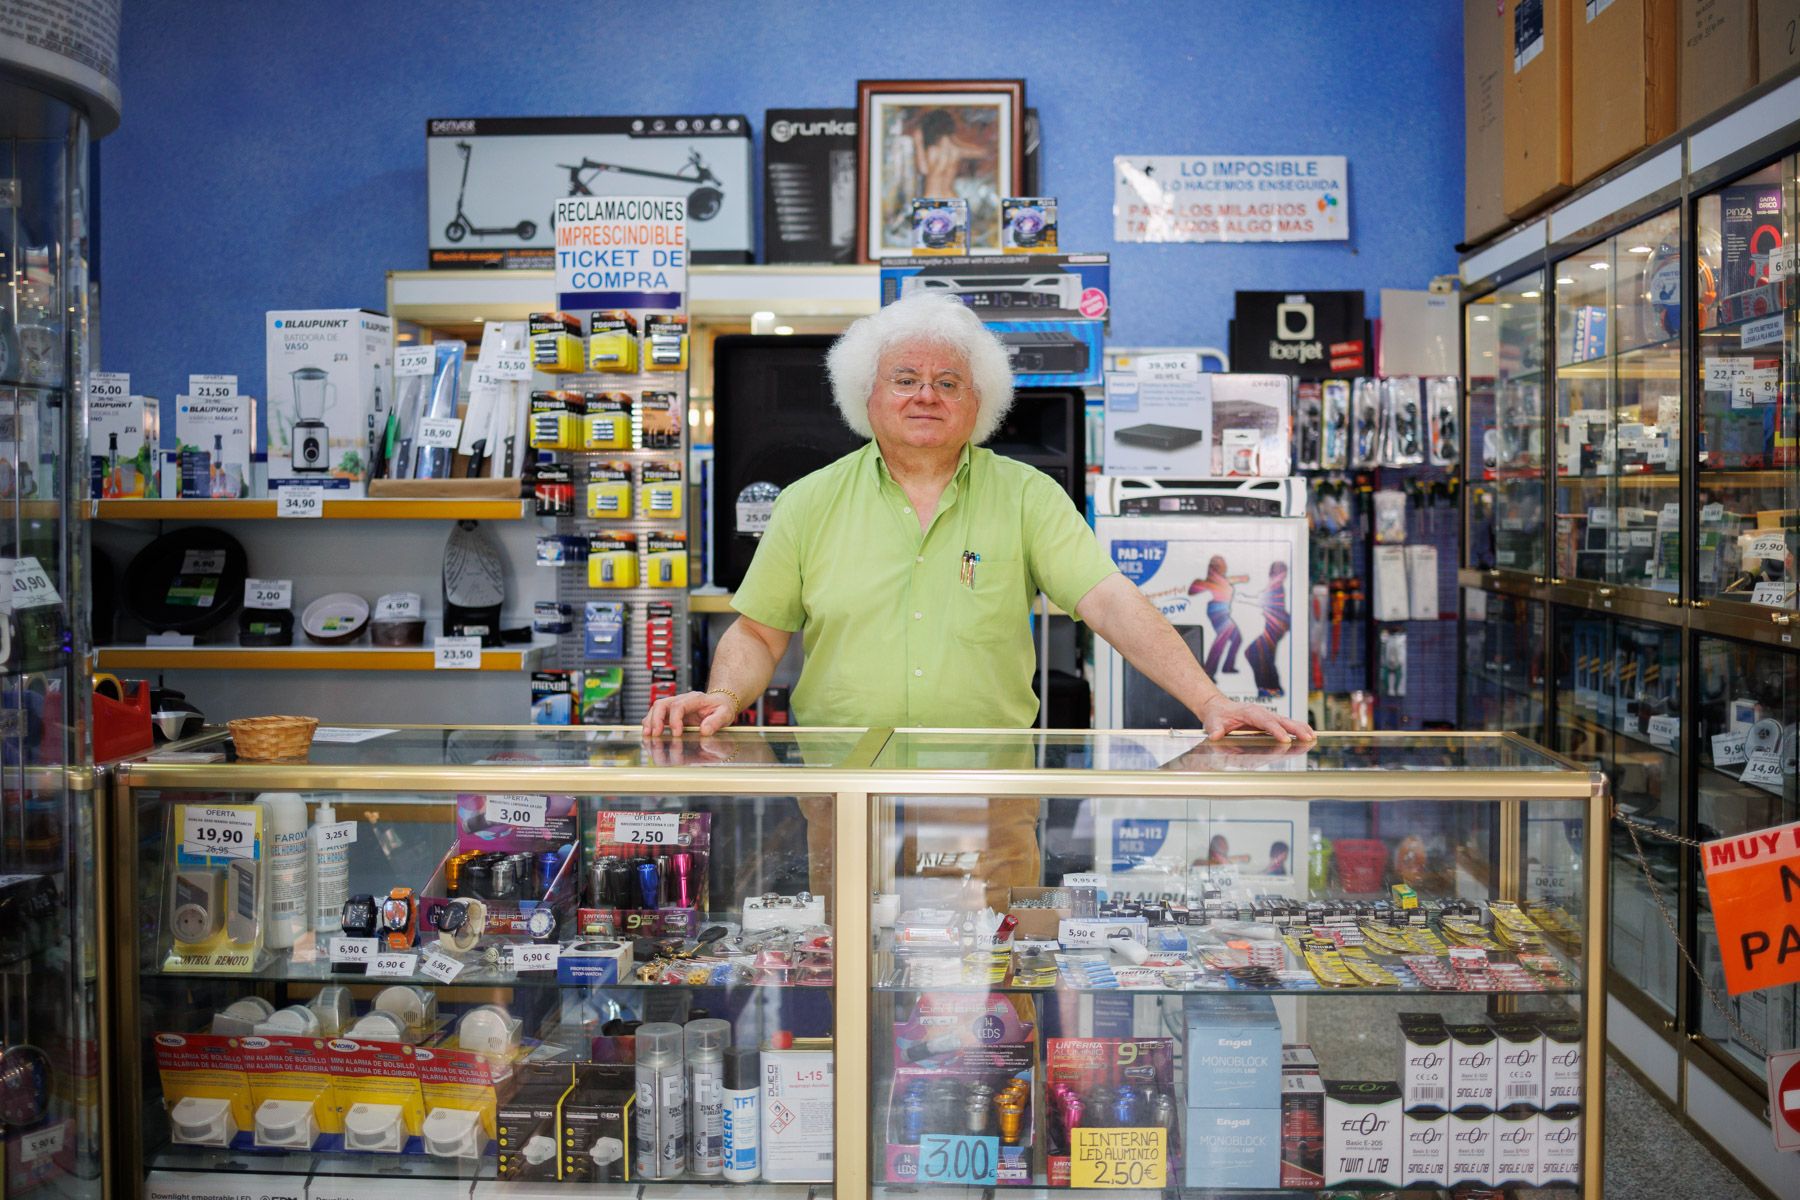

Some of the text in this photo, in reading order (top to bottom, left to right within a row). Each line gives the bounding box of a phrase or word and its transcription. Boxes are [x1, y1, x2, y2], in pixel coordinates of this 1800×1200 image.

[1181, 161, 1319, 177] LO IMPOSIBLE
[1185, 179, 1254, 192] HACEMOS
[1259, 179, 1340, 191] ENSEGUIDA
[558, 201, 684, 222] RECLAMACIONES
[1128, 203, 1307, 217] PA LOS MILAGROS
[1226, 220, 1273, 233] ALGO
[557, 226, 684, 247] IMPRESCINDIBLE
[559, 250, 684, 268] TICKET DE
[571, 271, 669, 290] COMPRA
[284, 319, 349, 329] BLAUPUNKT
[531, 322, 564, 331] TOSHIBA
[593, 320, 625, 329] TOSHIBA
[285, 342, 309, 351] VASO
[1269, 340, 1323, 363] iberjet
[400, 356, 428, 368] 17,50
[498, 360, 526, 371] 15,50
[91, 385, 122, 396] 26,00
[198, 387, 230, 398] 21,50
[90, 401, 133, 409] LAUPUNKT
[533, 401, 566, 409] TOSHIBA
[587, 402, 621, 410] TOSHIBA
[424, 428, 452, 438] 18,90
[590, 471, 625, 479] TOSHIBA
[644, 471, 679, 479] TOSHIBA
[285, 498, 316, 509] 34,90
[591, 541, 626, 549] TOSHIBA
[649, 541, 684, 549] TOSHIBA
[1753, 542, 1784, 552] 19,90
[1117, 548, 1163, 560] PAB-112
[256, 590, 281, 601] 2,00
[386, 602, 409, 611] 4,90
[587, 614, 622, 623] VARTA
[443, 650, 473, 660] 23,50
[531, 680, 568, 691] maxell
[585, 678, 600, 689] GP
[1751, 763, 1781, 775] 14,90
[206, 809, 236, 818] OFERTA
[499, 808, 531, 823] 3,00
[196, 826, 243, 844] 19,90
[325, 831, 343, 841] 3,25
[631, 830, 663, 845] 2,50
[1118, 827, 1163, 839] PAB-112
[1710, 831, 1781, 866] MUY
[627, 914, 641, 929] 9
[1068, 928, 1096, 938] 5,90 €
[340, 945, 368, 954] 6,90 €
[1740, 924, 1800, 971] PA
[215, 955, 249, 966] REMOTO
[523, 952, 550, 962] 6,90 €
[377, 960, 406, 969] 6,90 €
[431, 960, 453, 974] 6,90 €
[977, 1028, 1001, 1039] LEDS
[244, 1039, 266, 1047] NORU
[335, 1041, 356, 1050] NORU
[1218, 1038, 1253, 1048] Engel
[1056, 1041, 1103, 1049] LINTERNA
[1117, 1043, 1137, 1065] 9
[1201, 1056, 1269, 1067] MONOBLOCK
[797, 1071, 823, 1081] L-15
[1457, 1088, 1478, 1098] SINGLE
[1550, 1086, 1571, 1097] SINGLE
[734, 1096, 756, 1109] TFT
[1216, 1118, 1250, 1128] Engel
[723, 1109, 734, 1170] SCREEN
[1080, 1132, 1159, 1147] LINTERNA
[1200, 1136, 1267, 1146] MONOBLOCK
[1080, 1148, 1159, 1161] LED ALUMINIO
[898, 1164, 917, 1175] LEDS
[1340, 1157, 1389, 1173] TWIN LNB
[1408, 1164, 1430, 1173] SINGLE
[1453, 1163, 1475, 1173] SINGLE
[1498, 1163, 1520, 1174] SINGLE
[1543, 1163, 1565, 1173] SINGLE
[151, 1192, 190, 1200] Downlight
